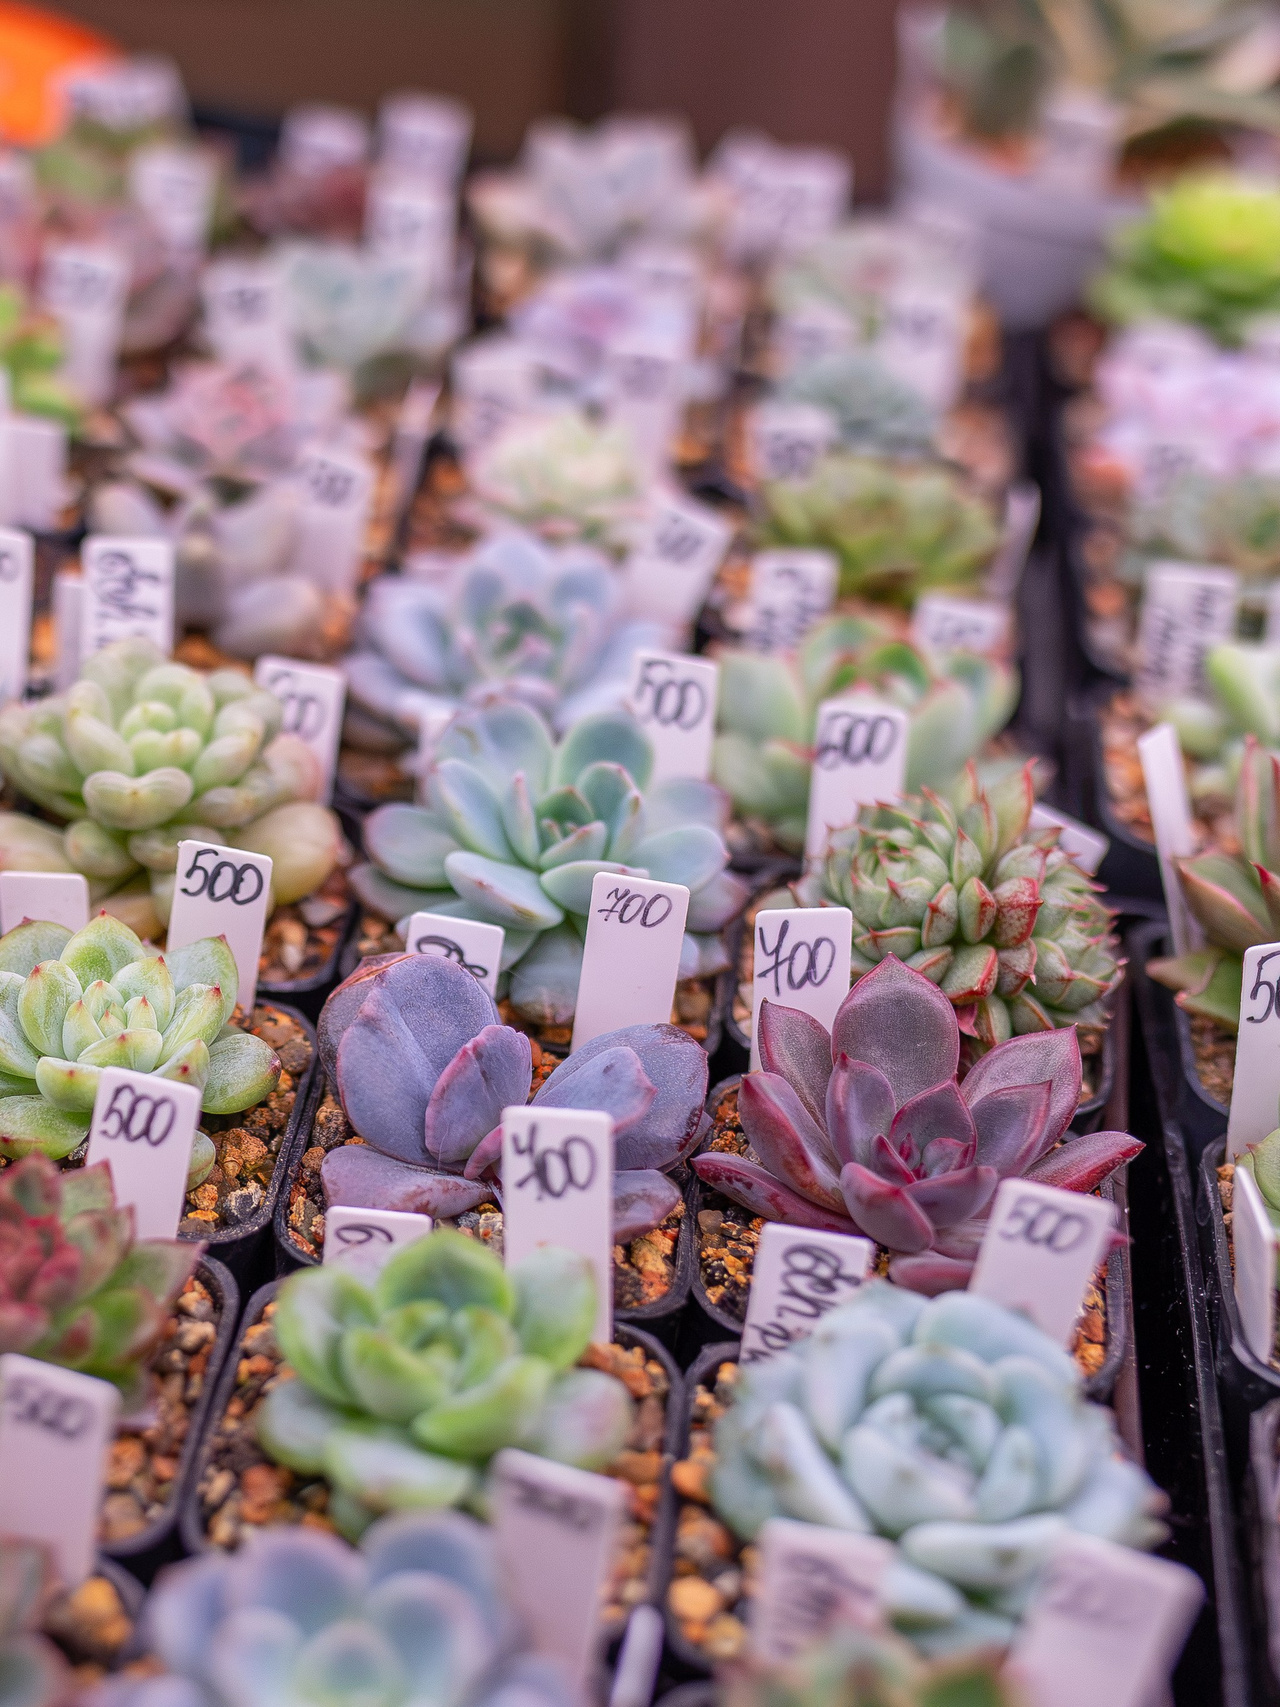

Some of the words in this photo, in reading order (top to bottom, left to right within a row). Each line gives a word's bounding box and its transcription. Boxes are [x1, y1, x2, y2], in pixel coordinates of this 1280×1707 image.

[635, 659, 707, 731] 500
[180, 848, 264, 906] 500
[597, 887, 673, 928] 700
[100, 1082, 177, 1147] 500
[998, 1194, 1092, 1254] 500
